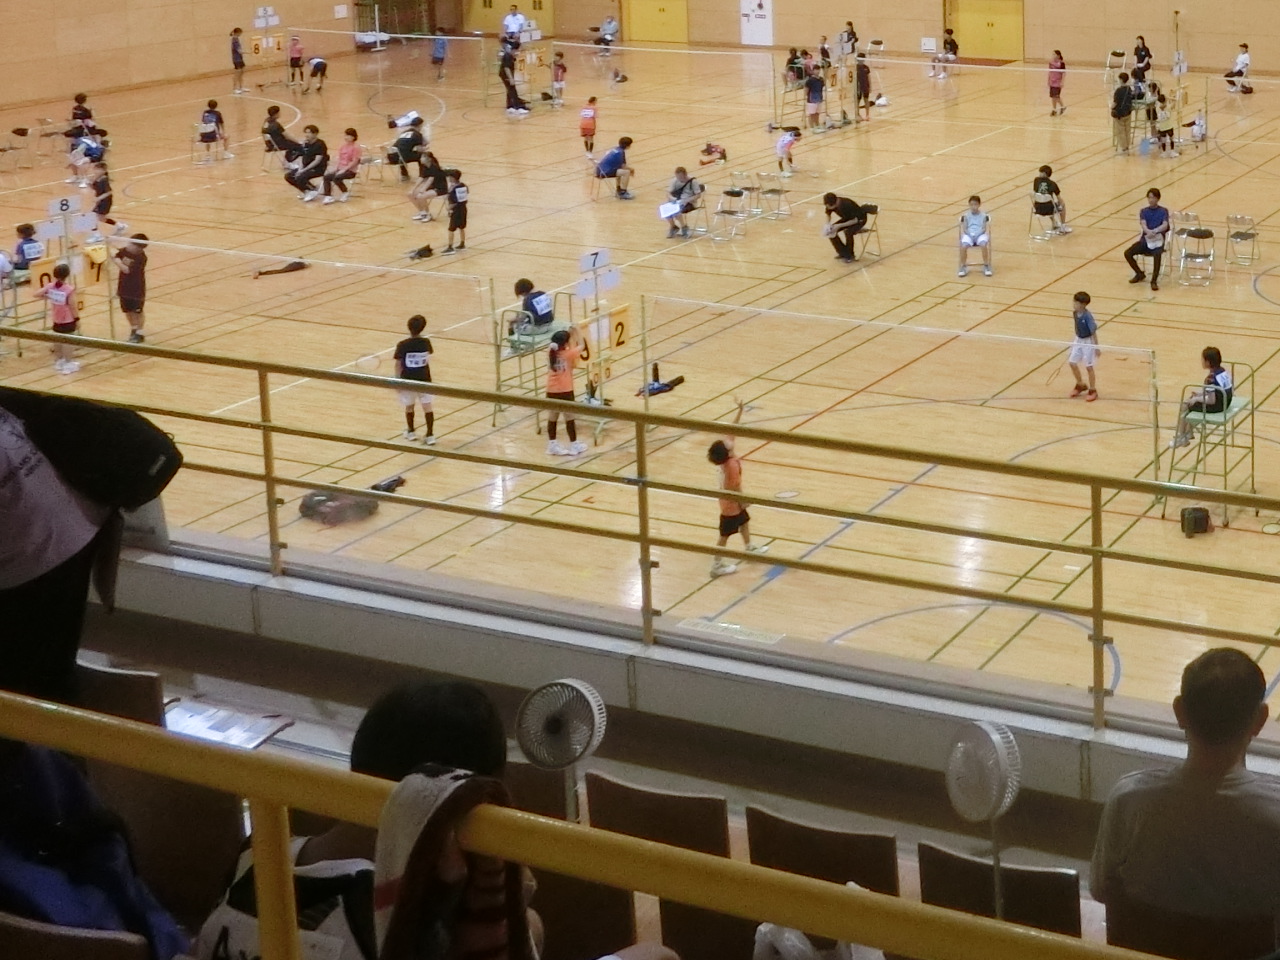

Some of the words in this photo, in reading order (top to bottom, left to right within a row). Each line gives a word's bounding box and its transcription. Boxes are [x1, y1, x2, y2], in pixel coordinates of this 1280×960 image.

[60, 198, 69, 211] 8
[590, 251, 599, 267] 7
[615, 322, 625, 347] 2
